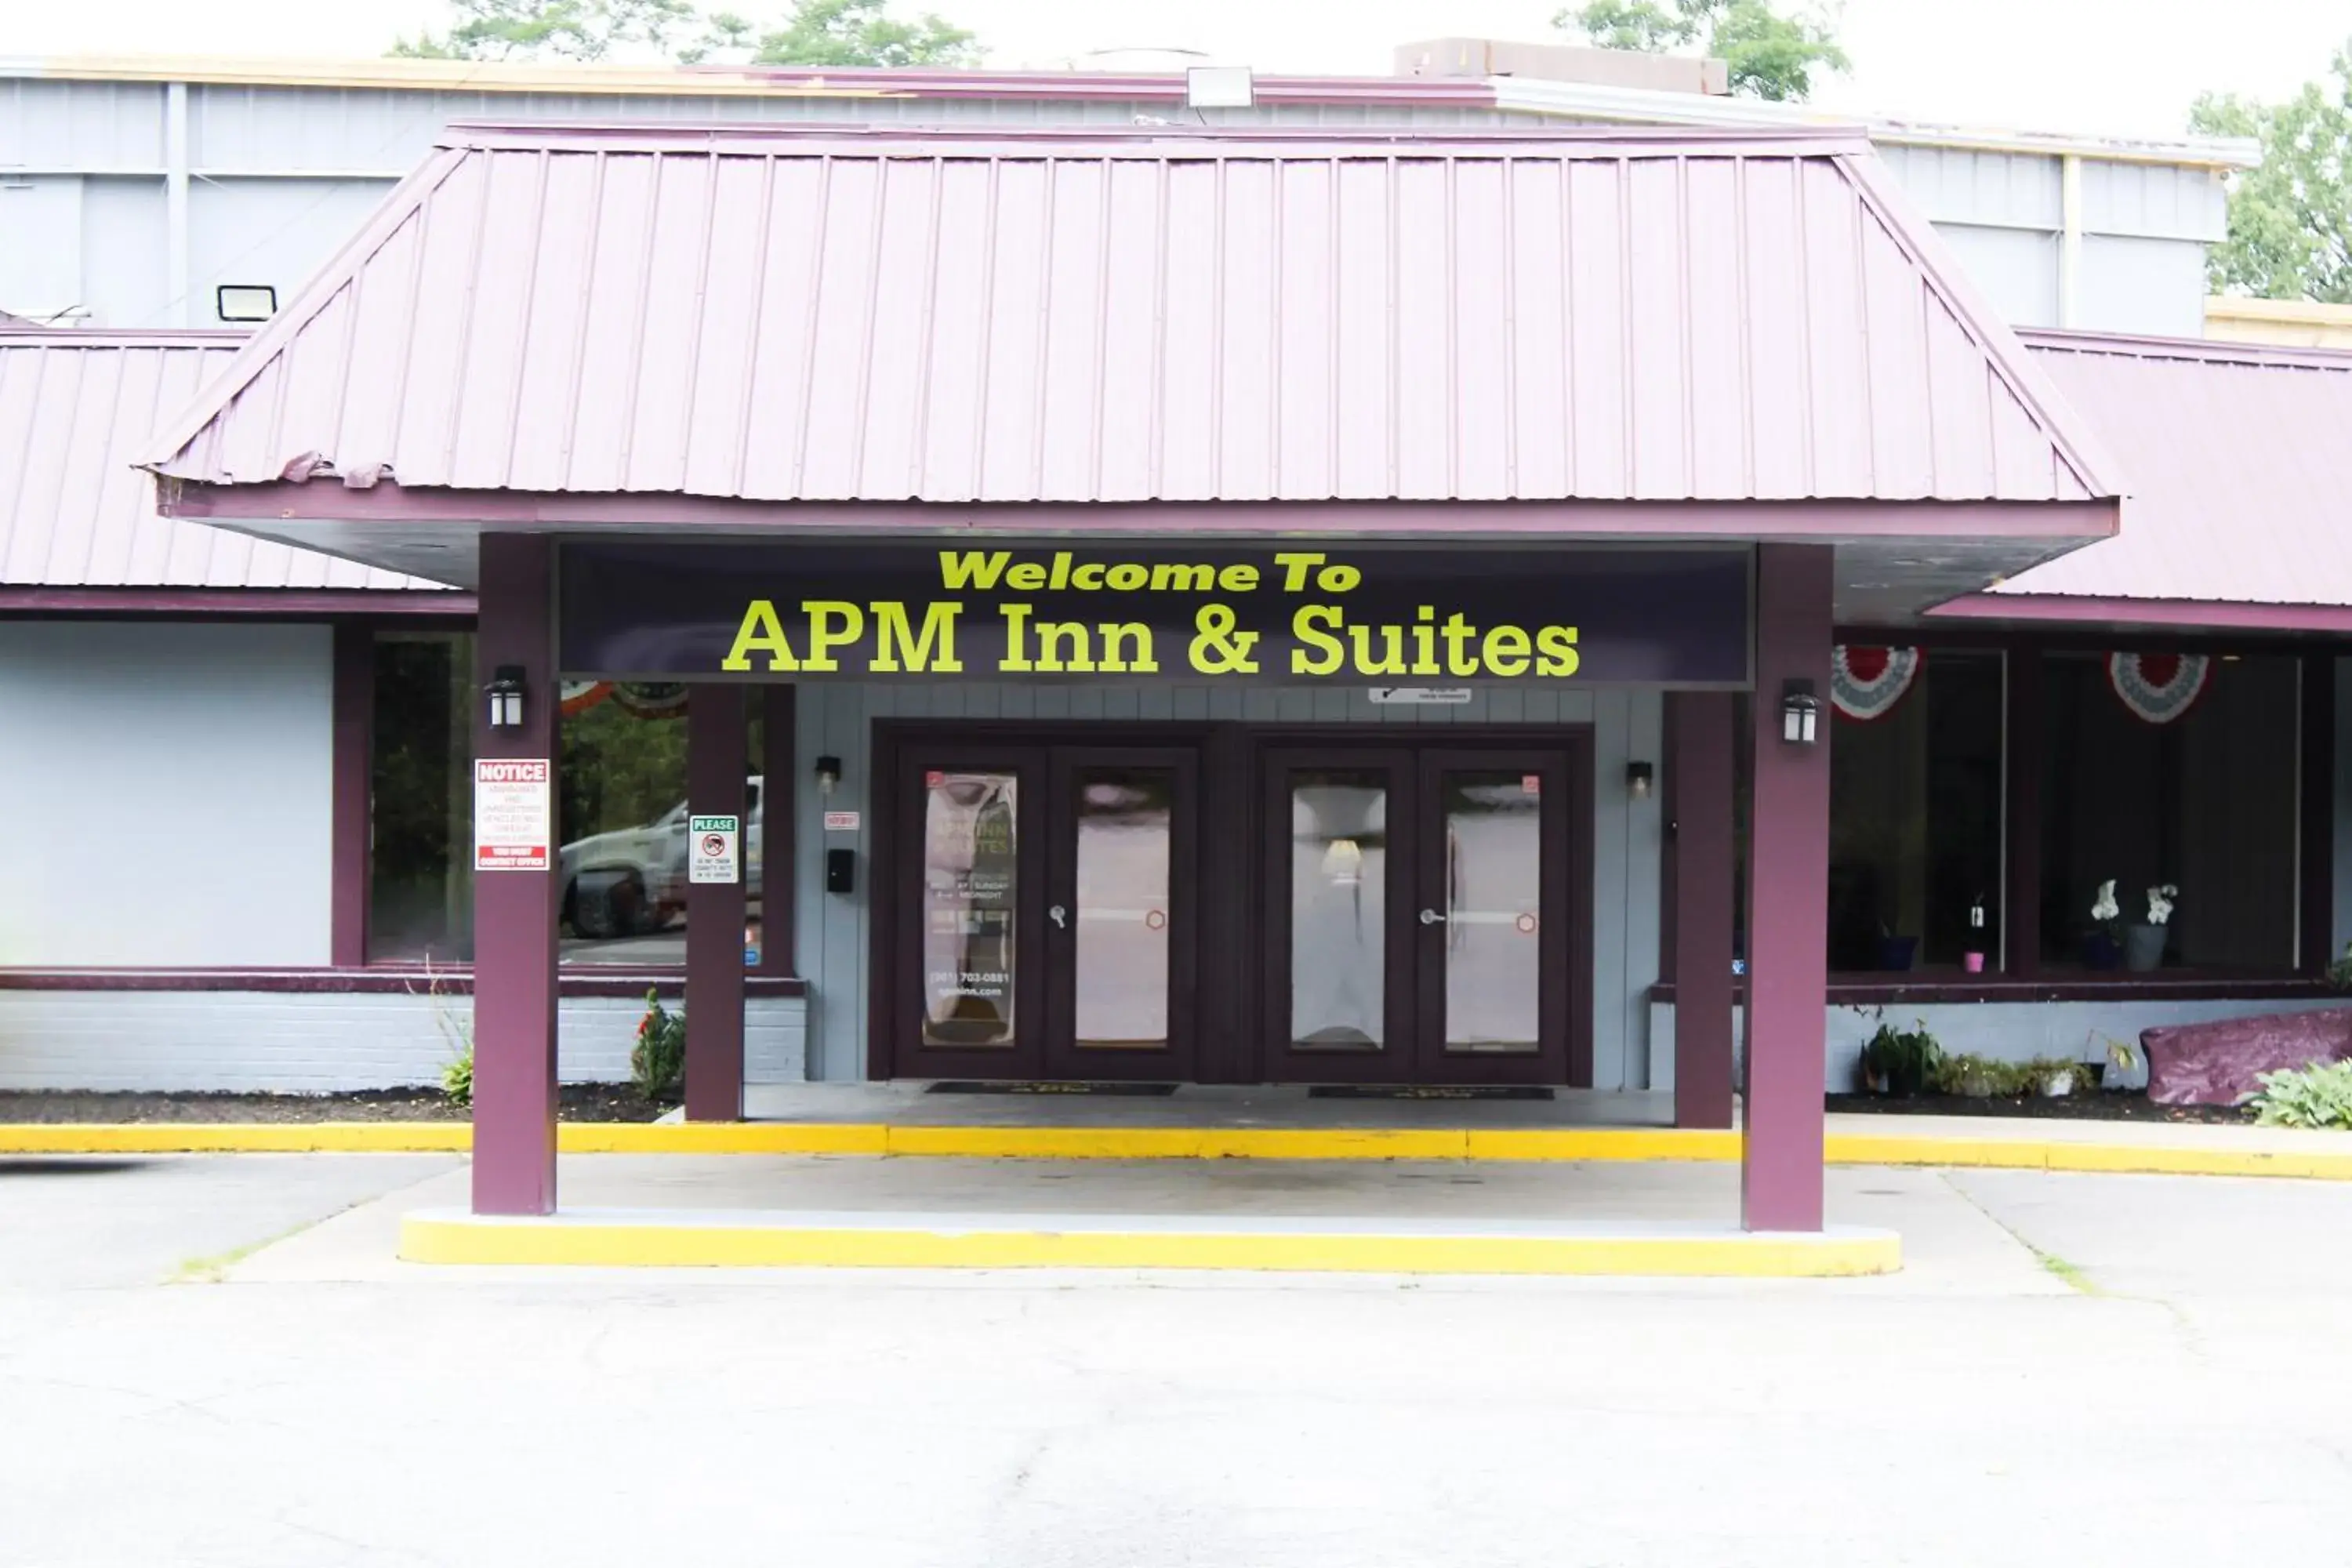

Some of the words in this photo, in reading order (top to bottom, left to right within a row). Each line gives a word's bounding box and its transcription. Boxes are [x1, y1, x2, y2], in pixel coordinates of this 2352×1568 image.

[939, 551, 1260, 591] Welcome
[1274, 553, 1362, 592] To
[723, 600, 964, 673] APM
[999, 603, 1160, 673] Inn
[1189, 603, 1260, 674] &
[1291, 604, 1580, 677] Suites
[480, 764, 545, 781] NOTICE
[694, 819, 733, 830] PLEASE
